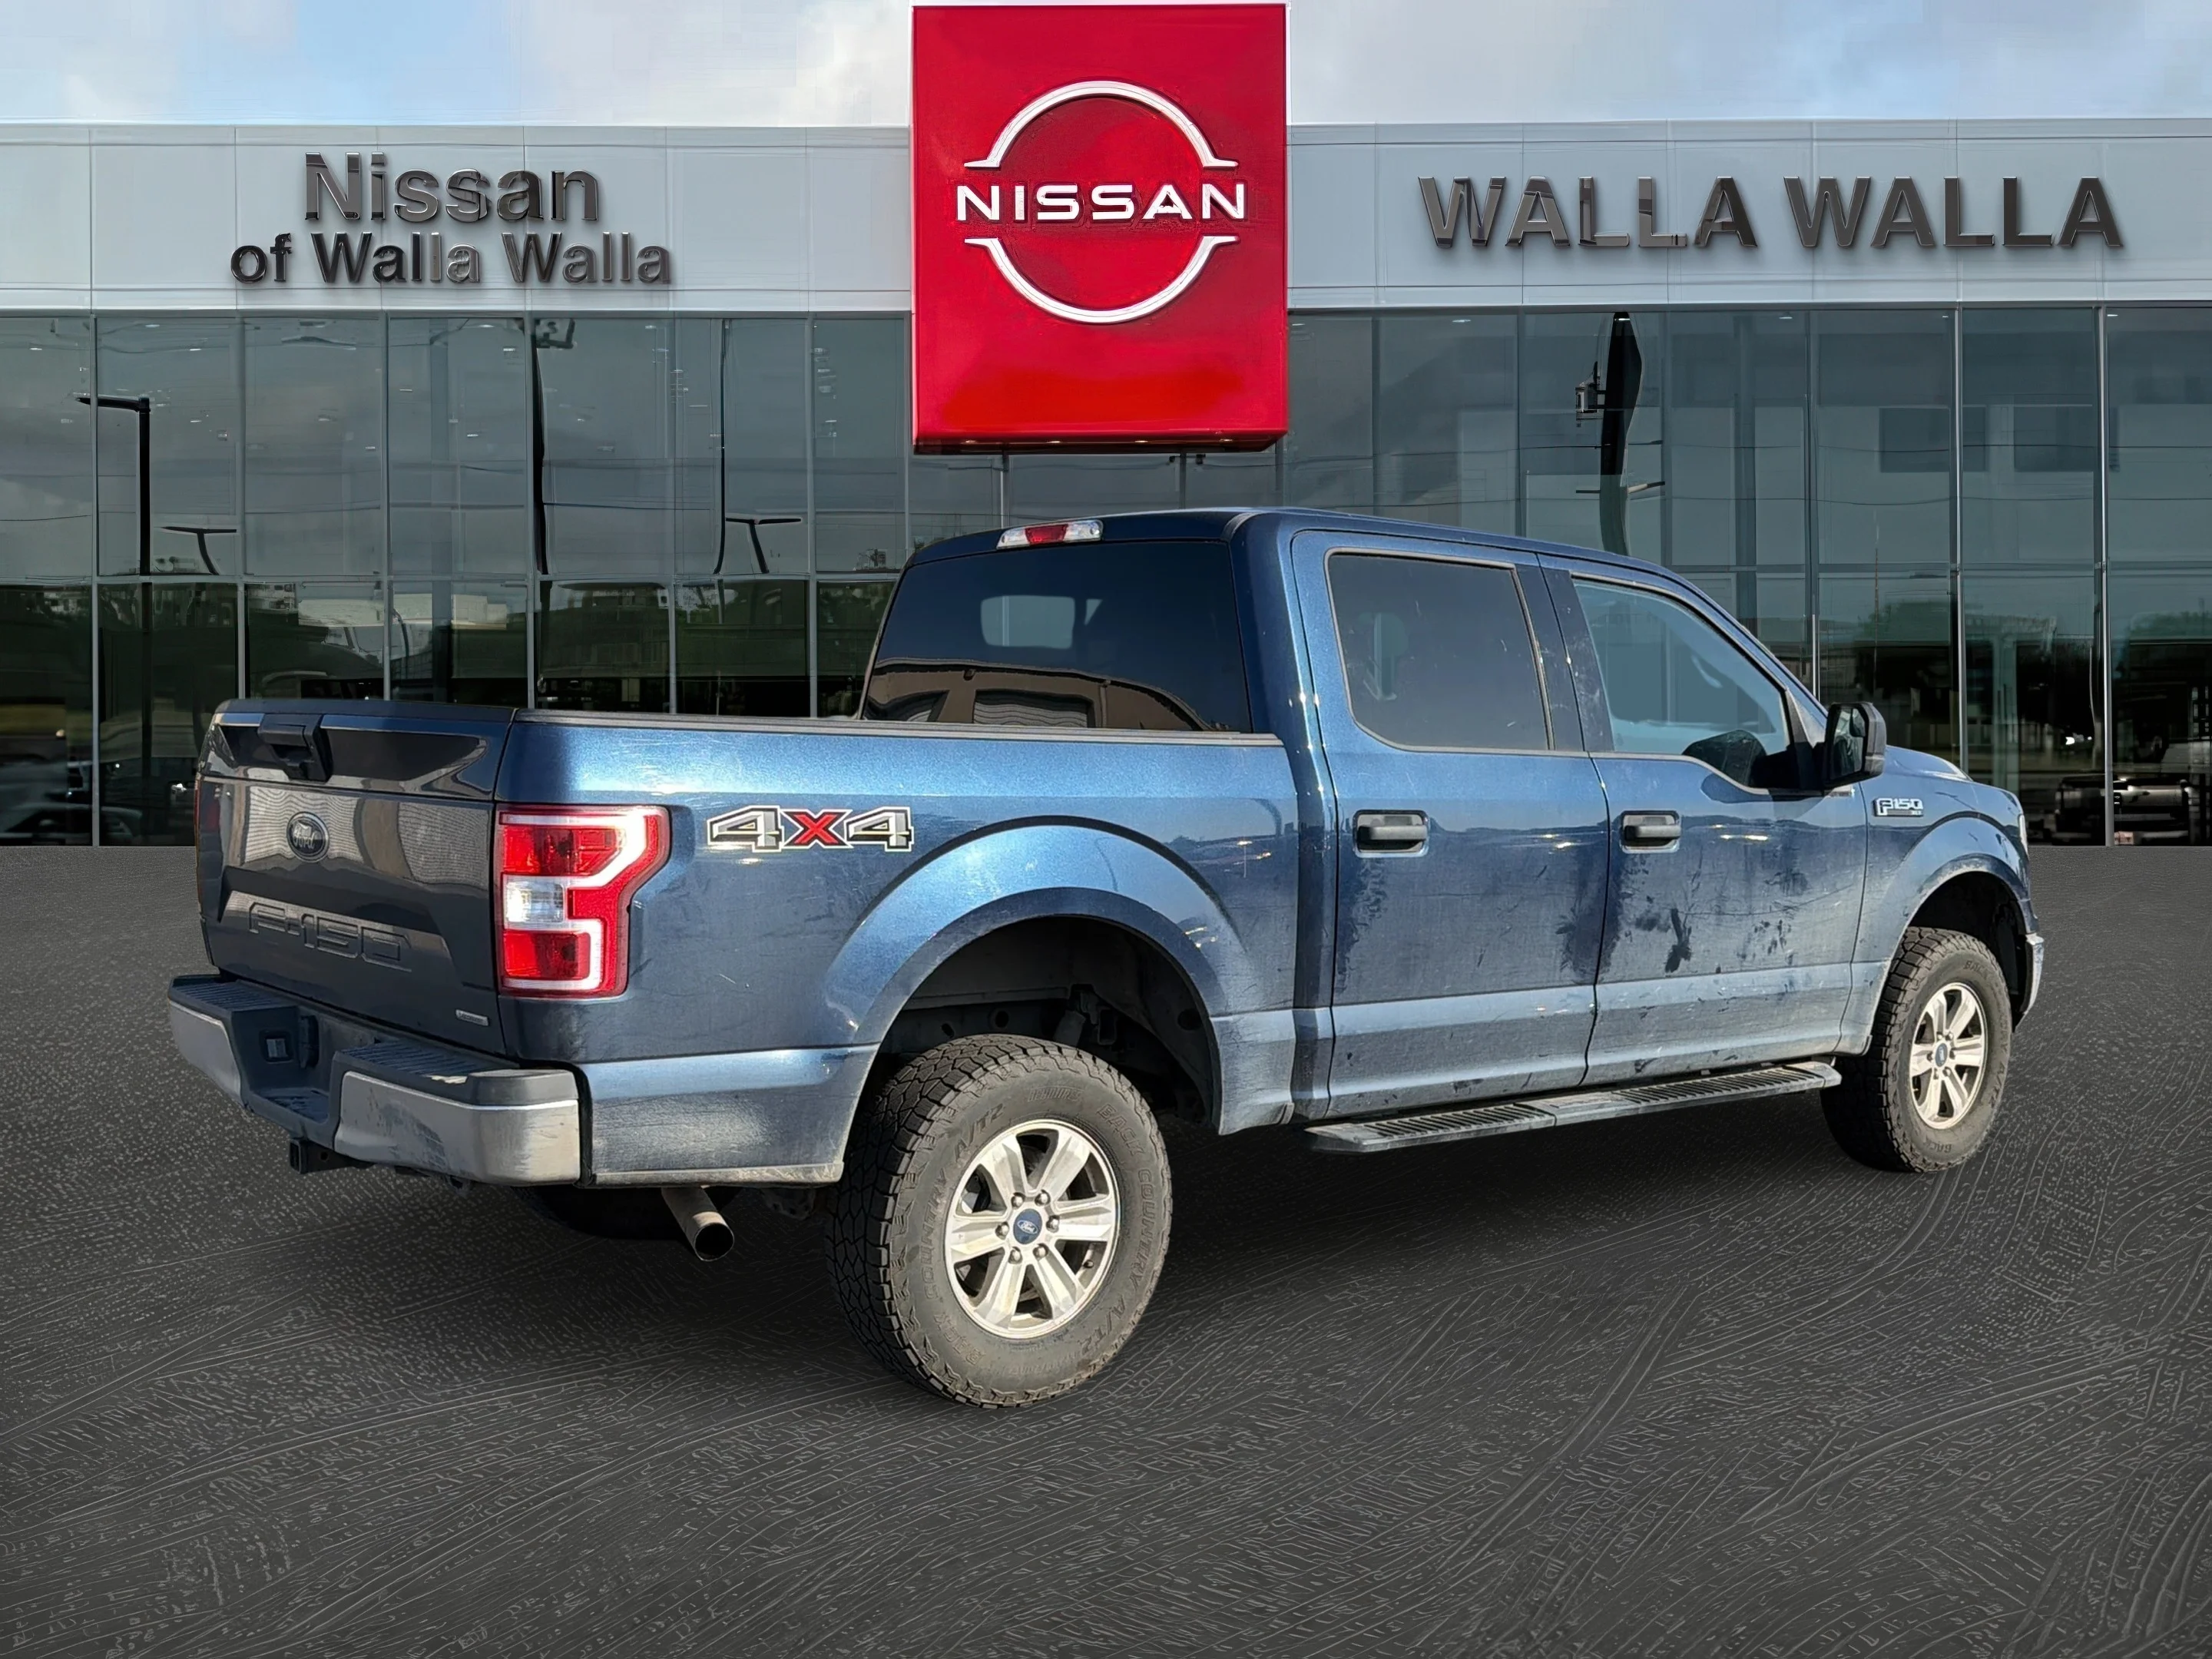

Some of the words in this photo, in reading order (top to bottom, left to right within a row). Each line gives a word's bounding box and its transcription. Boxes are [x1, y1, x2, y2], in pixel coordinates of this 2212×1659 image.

[304, 151, 599, 223] Nissan
[957, 184, 1245, 221] NISSAN
[1418, 176, 1759, 249] WALLA
[1783, 176, 2124, 249] WALLA
[230, 232, 293, 283] of
[310, 231, 482, 283] Walla
[501, 231, 671, 284] Walla
[1097, 1103, 1144, 1157] BACK
[1129, 1169, 1157, 1292] COUNTRY
